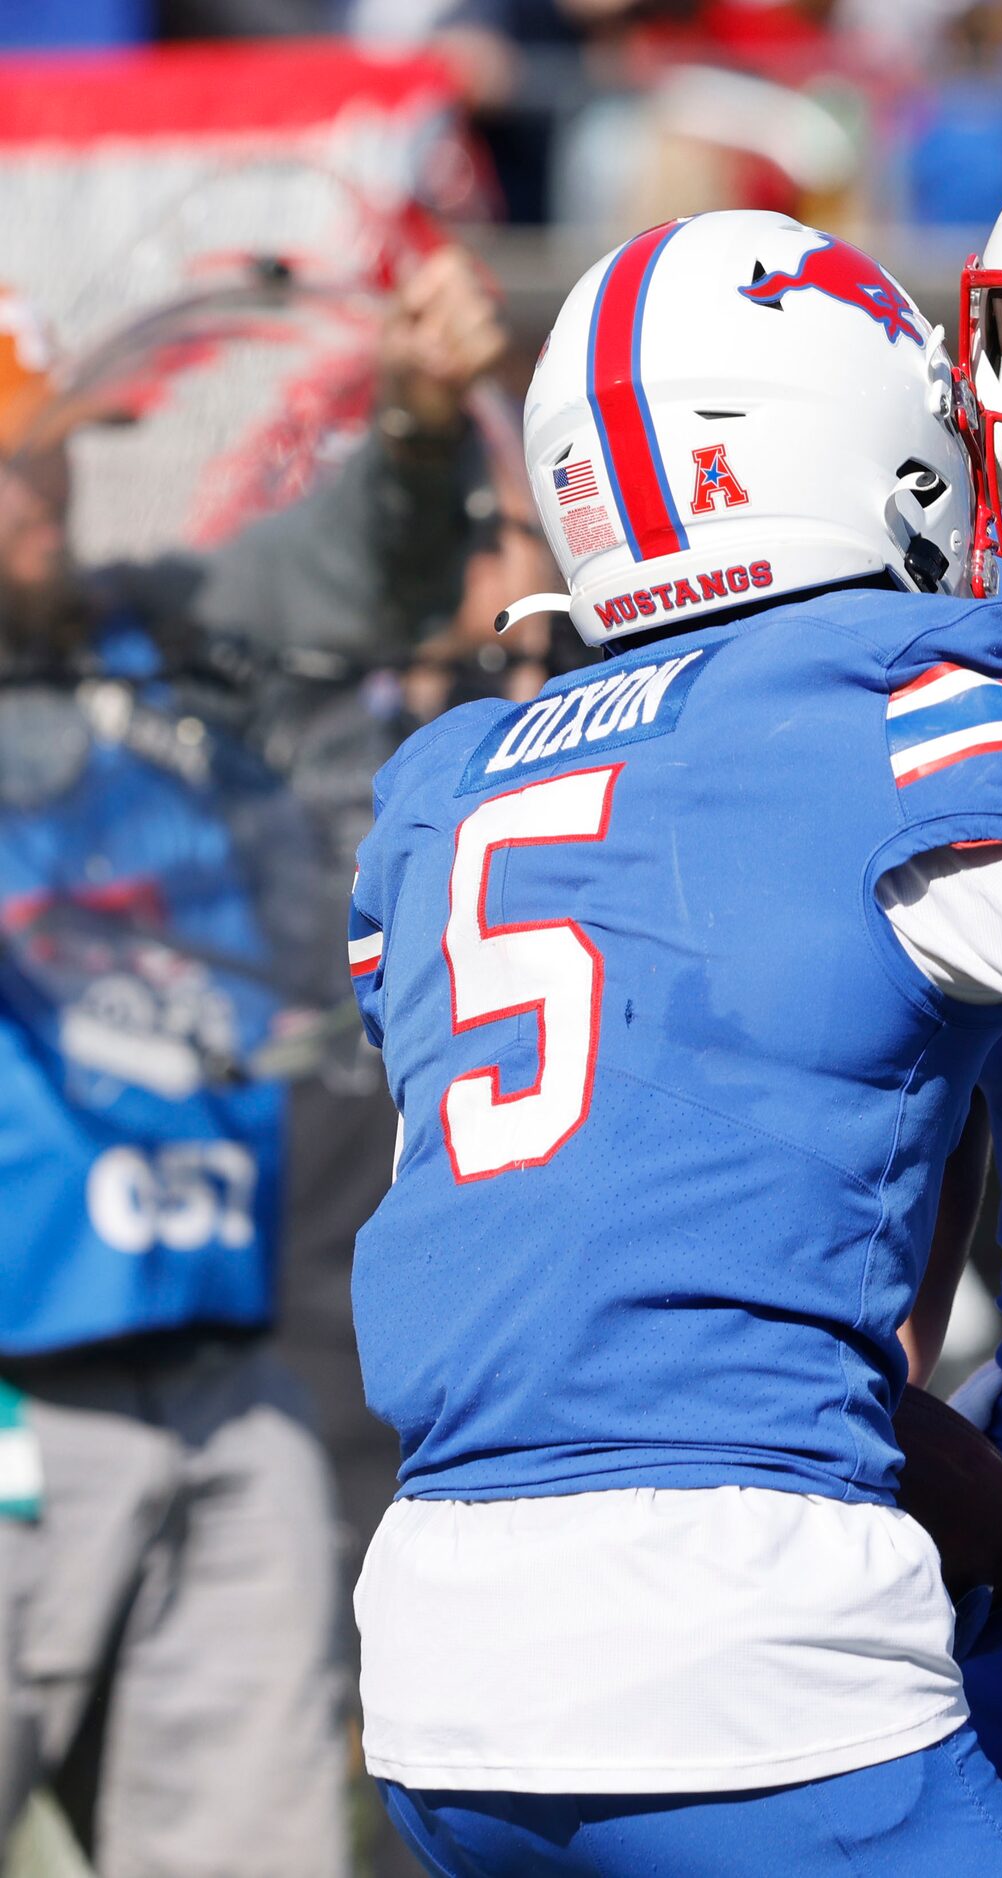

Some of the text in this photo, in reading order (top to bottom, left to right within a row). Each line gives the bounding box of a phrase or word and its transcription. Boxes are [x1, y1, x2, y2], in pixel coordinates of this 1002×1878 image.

[690, 443, 749, 514] A
[593, 560, 773, 630] MUSTANGS
[484, 649, 703, 774] DIXON
[439, 761, 626, 1185] 5
